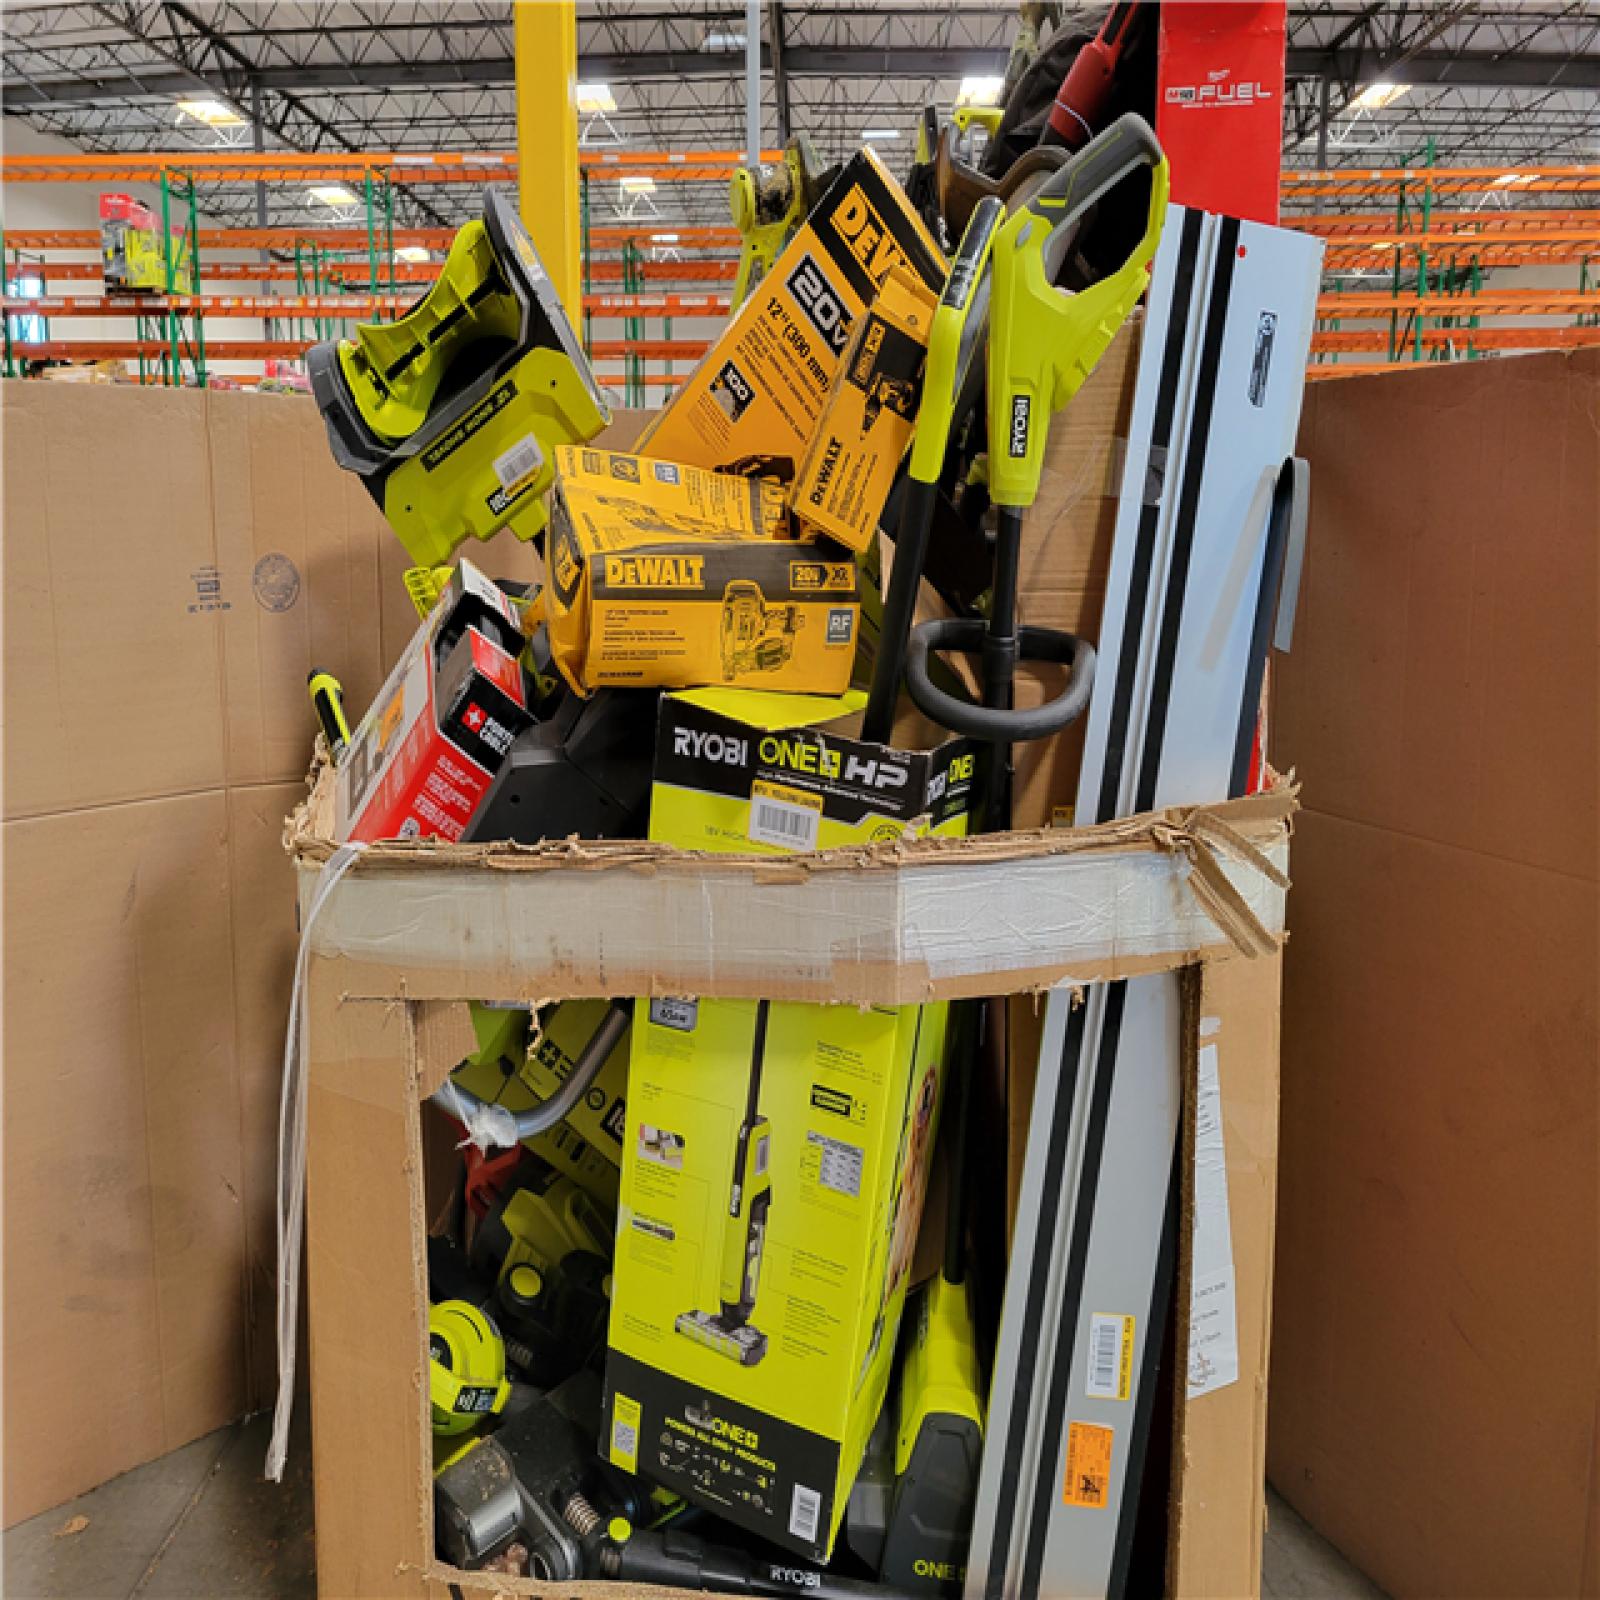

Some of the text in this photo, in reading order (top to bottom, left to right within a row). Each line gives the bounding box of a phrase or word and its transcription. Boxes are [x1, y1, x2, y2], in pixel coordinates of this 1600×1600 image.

[1199, 82, 1272, 101] FUEL
[1012, 399, 1029, 455] RYOBI
[674, 726, 748, 767] RYOBI
[844, 754, 909, 788] HP
[769, 1564, 821, 1588] RYOBI
